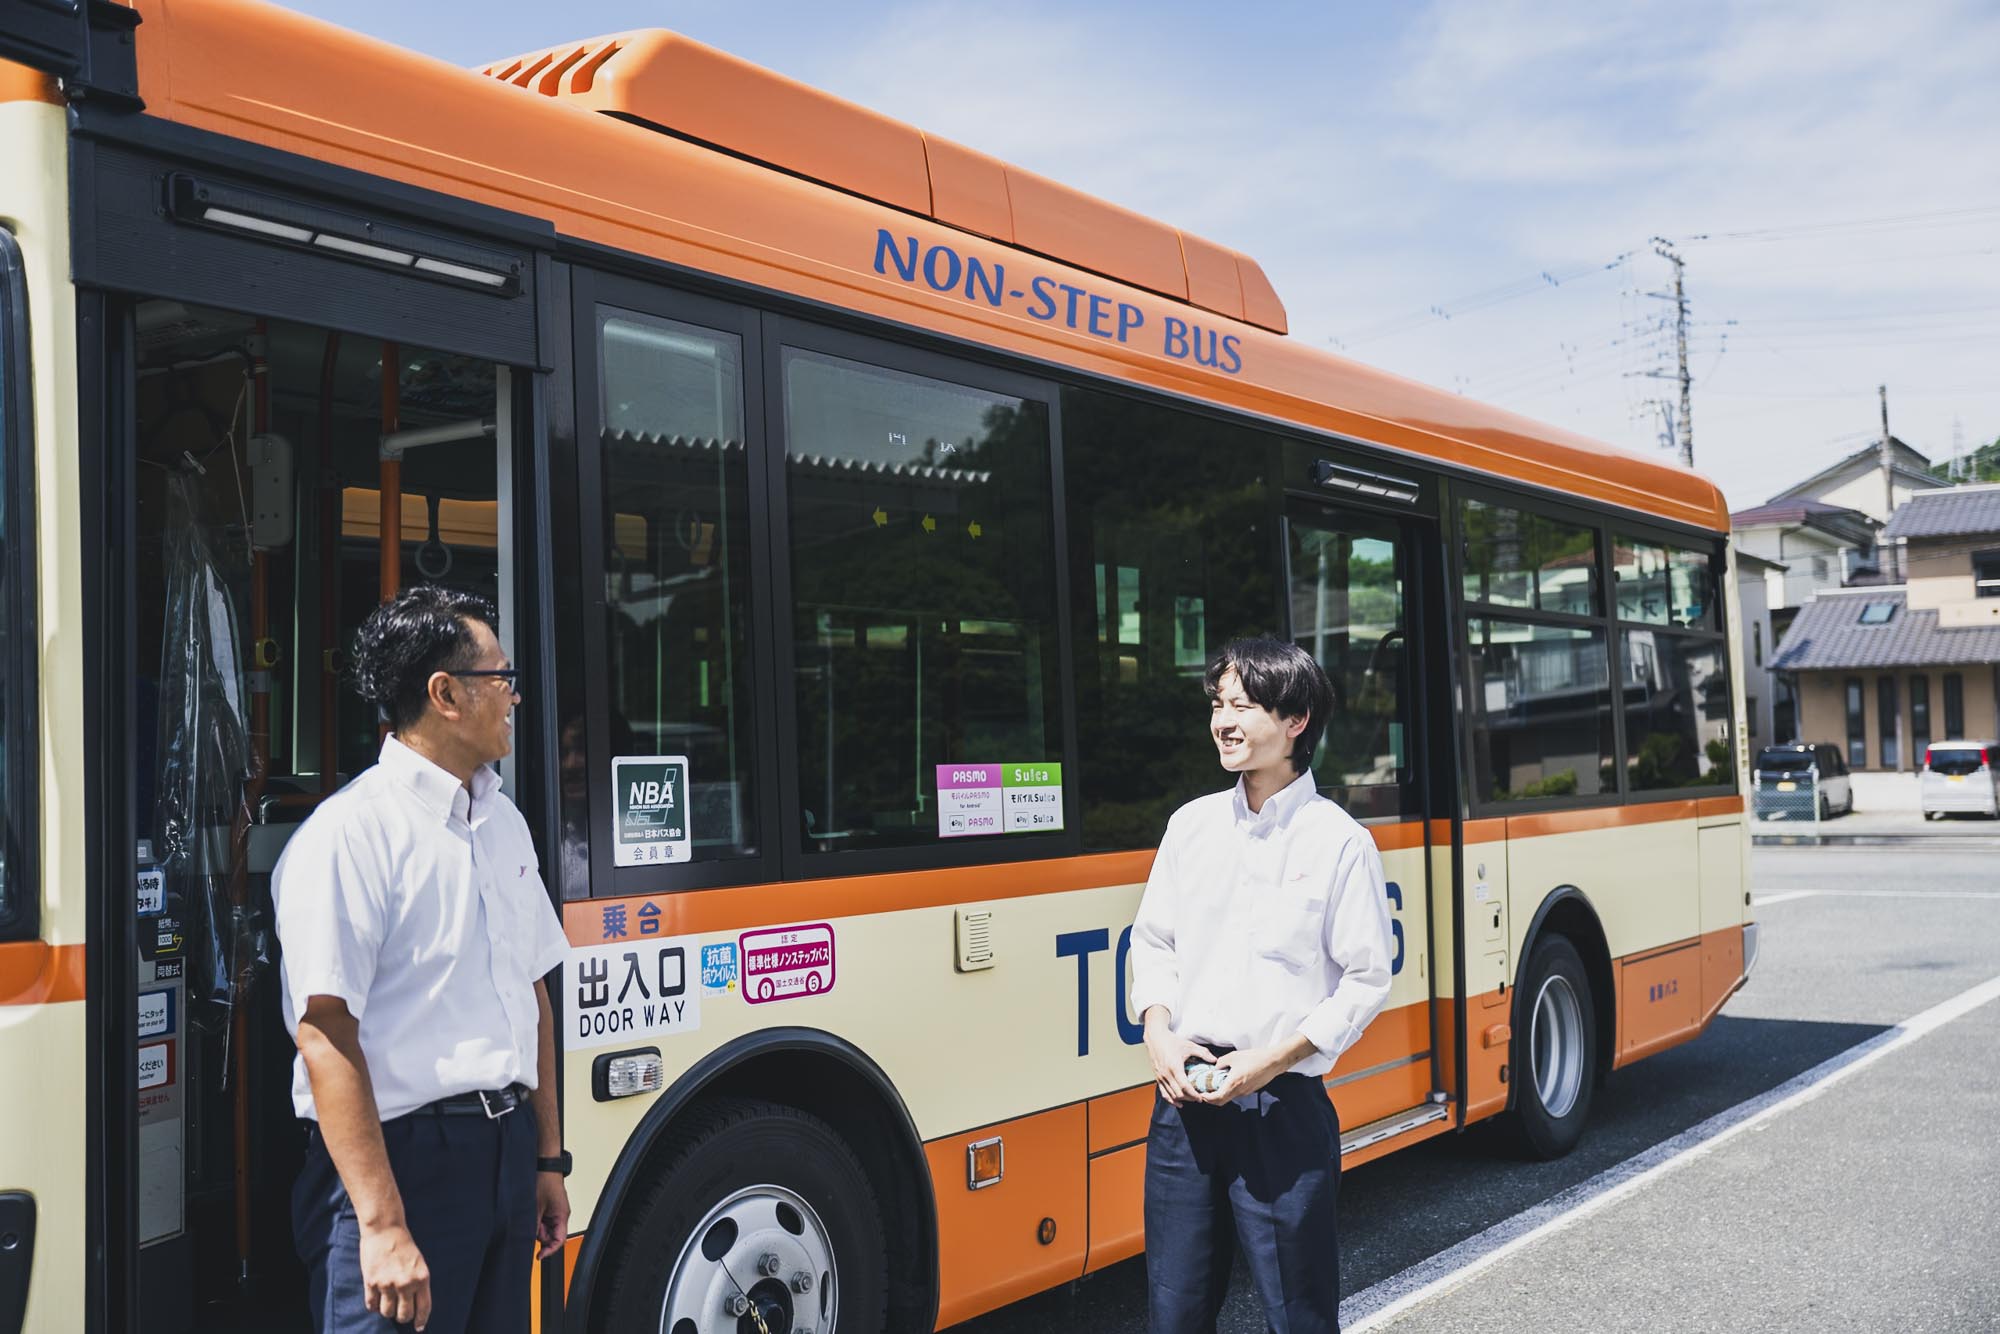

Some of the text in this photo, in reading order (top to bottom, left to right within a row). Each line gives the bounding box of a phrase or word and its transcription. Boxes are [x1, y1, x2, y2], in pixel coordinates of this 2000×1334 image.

[873, 228, 1243, 375] NON-STEP BUS
[952, 770, 987, 783] PASMO
[1015, 768, 1049, 782] Suica
[629, 781, 674, 805] NBA
[1011, 793, 1056, 803] モバイルSuica
[968, 817, 994, 827] PASMO
[1033, 814, 1054, 824] Suica
[602, 901, 662, 939] 乗合
[159, 935, 172, 945] 1000
[706, 946, 733, 967] 抗菌
[578, 946, 687, 1010] 出入口
[703, 965, 737, 985] 抗ウイルス
[579, 999, 686, 1038] DOOR WAY
